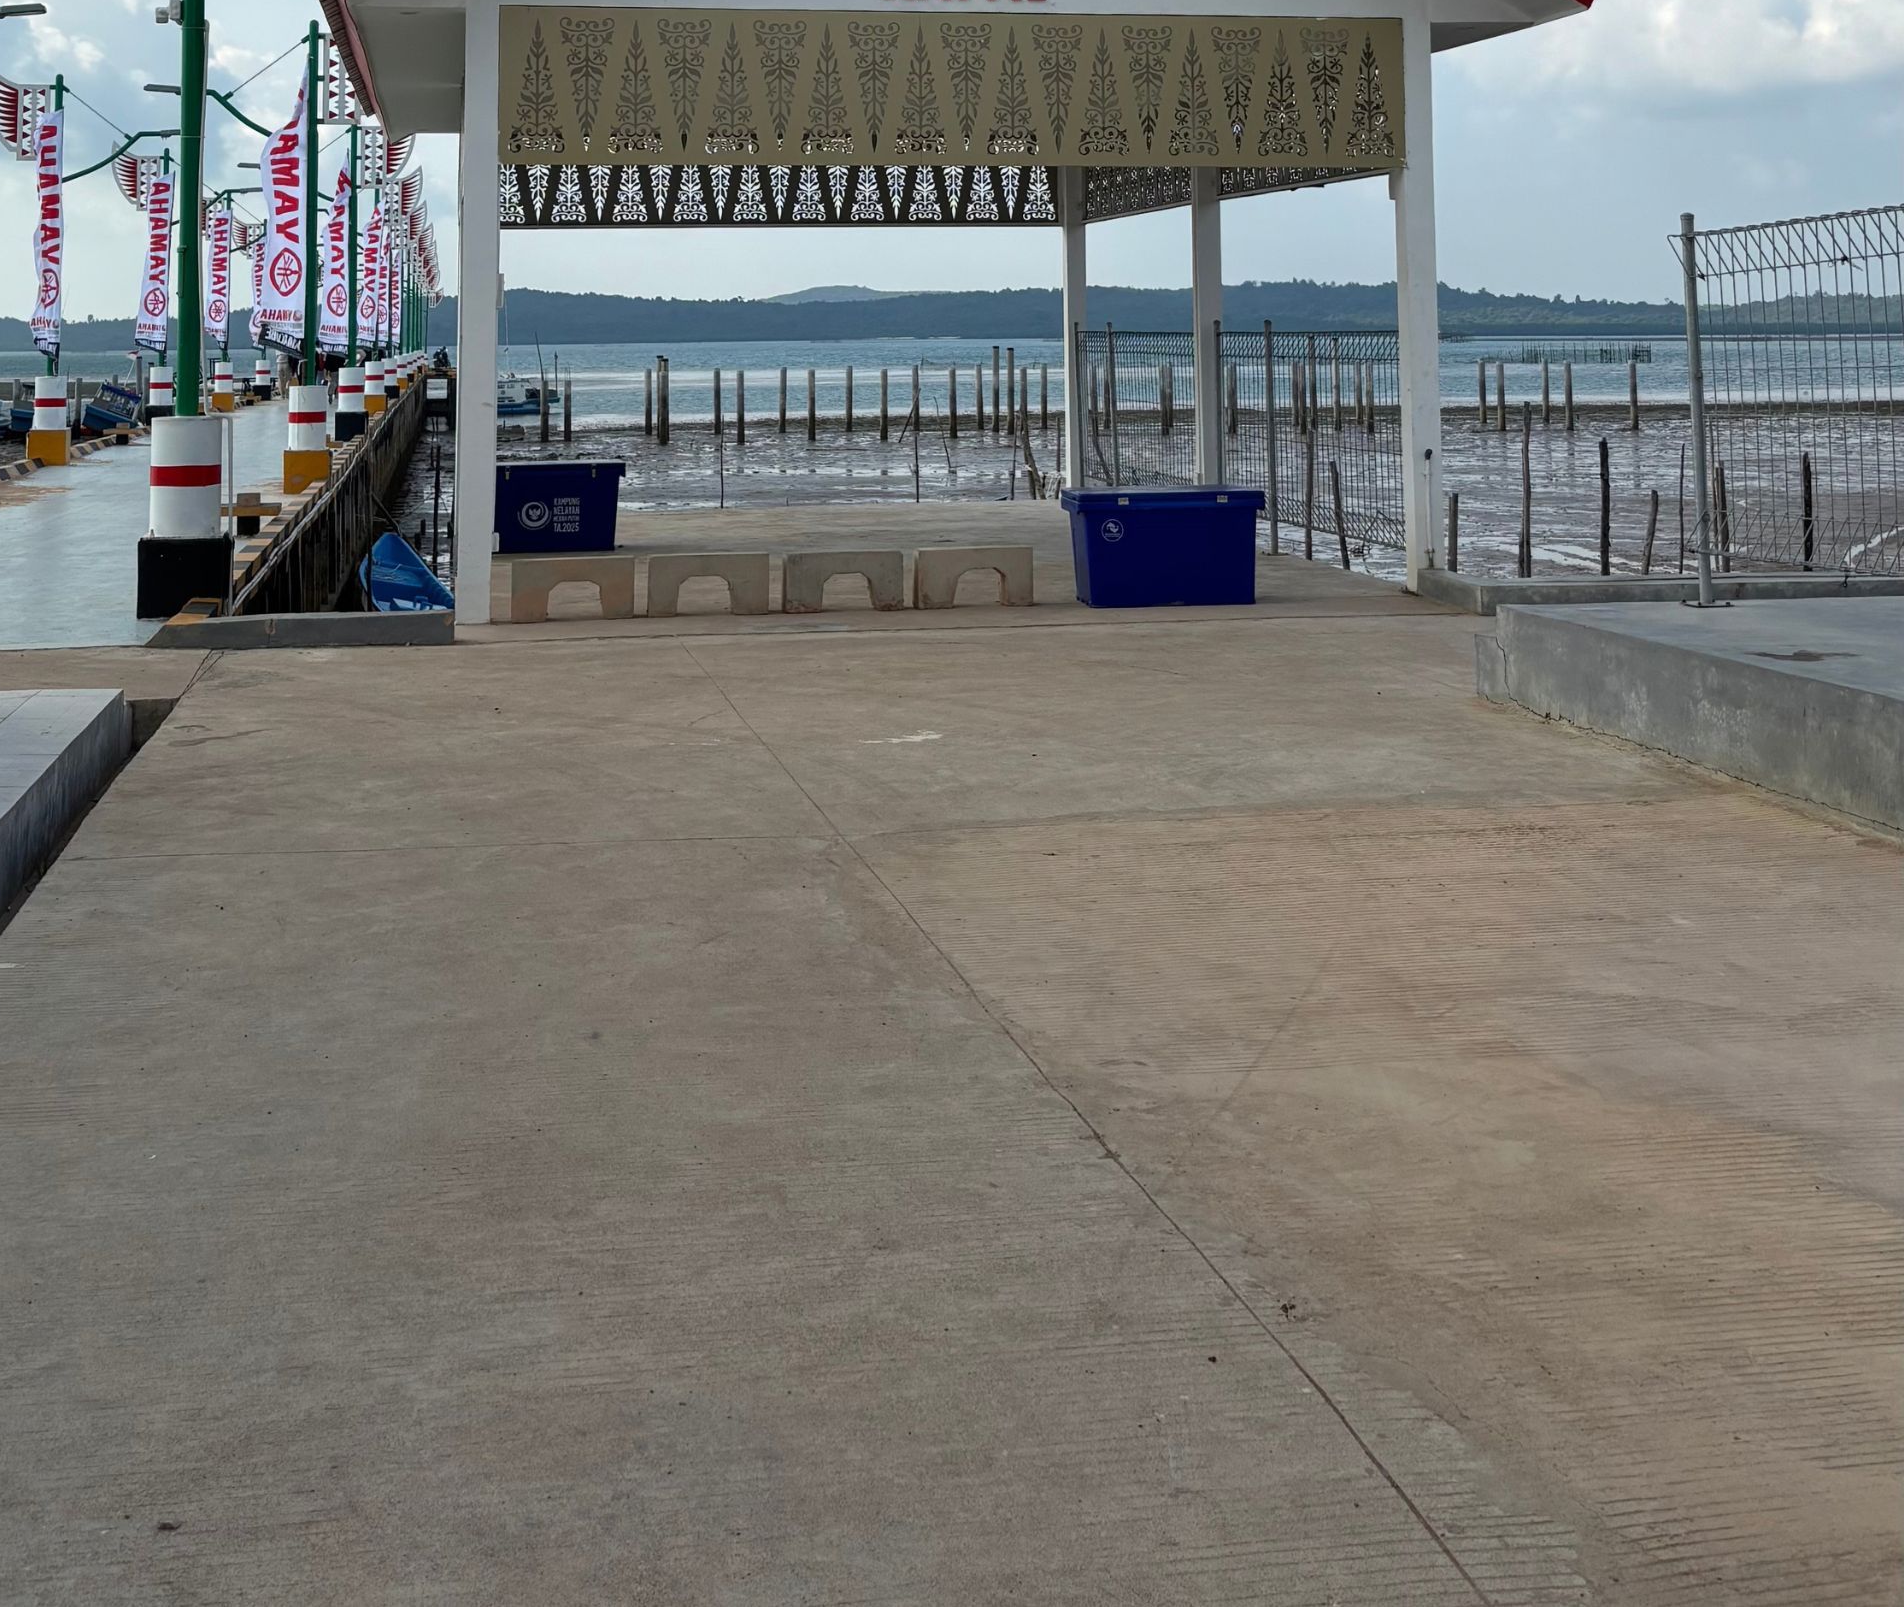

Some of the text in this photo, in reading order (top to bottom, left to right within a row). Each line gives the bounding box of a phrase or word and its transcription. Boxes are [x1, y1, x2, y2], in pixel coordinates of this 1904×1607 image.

[553, 498, 580, 506] KAMPUNG
[553, 506, 580, 515] NELAYAN
[554, 522, 580, 532] TA.2025
